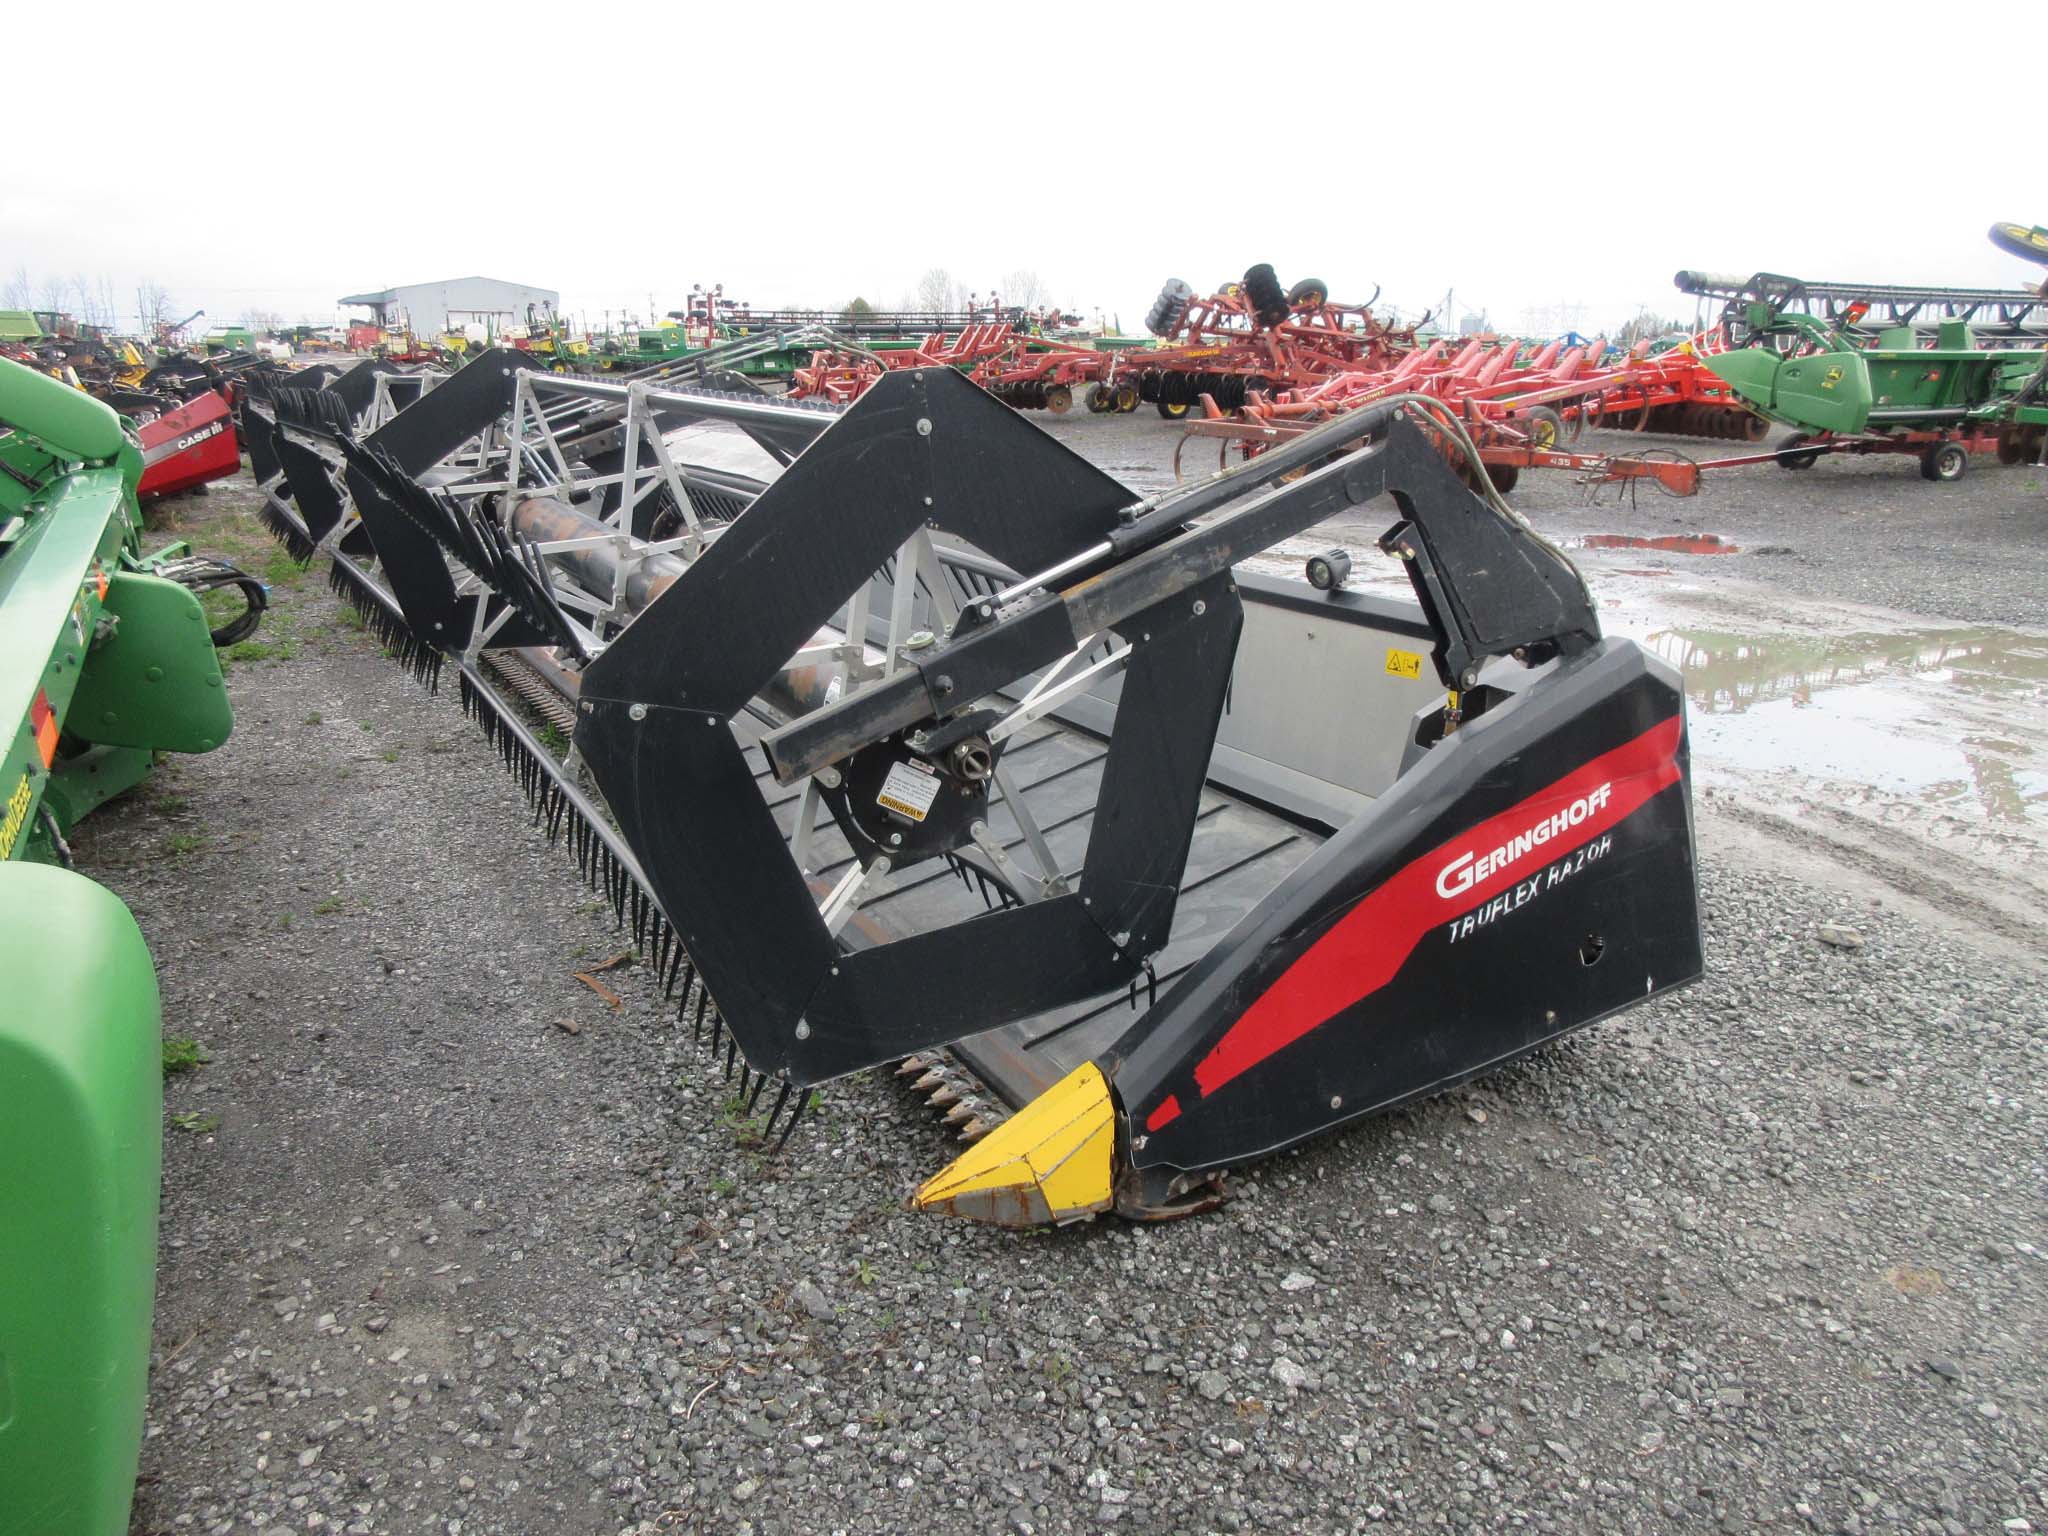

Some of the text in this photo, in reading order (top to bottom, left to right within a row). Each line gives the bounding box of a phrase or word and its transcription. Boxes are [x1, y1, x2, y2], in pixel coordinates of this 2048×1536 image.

[178, 429, 211, 450] CASE
[0, 817, 17, 862] OHN
[1436, 782, 1611, 899] GERINGHOFF
[1450, 873, 1542, 943] TRUFLEX
